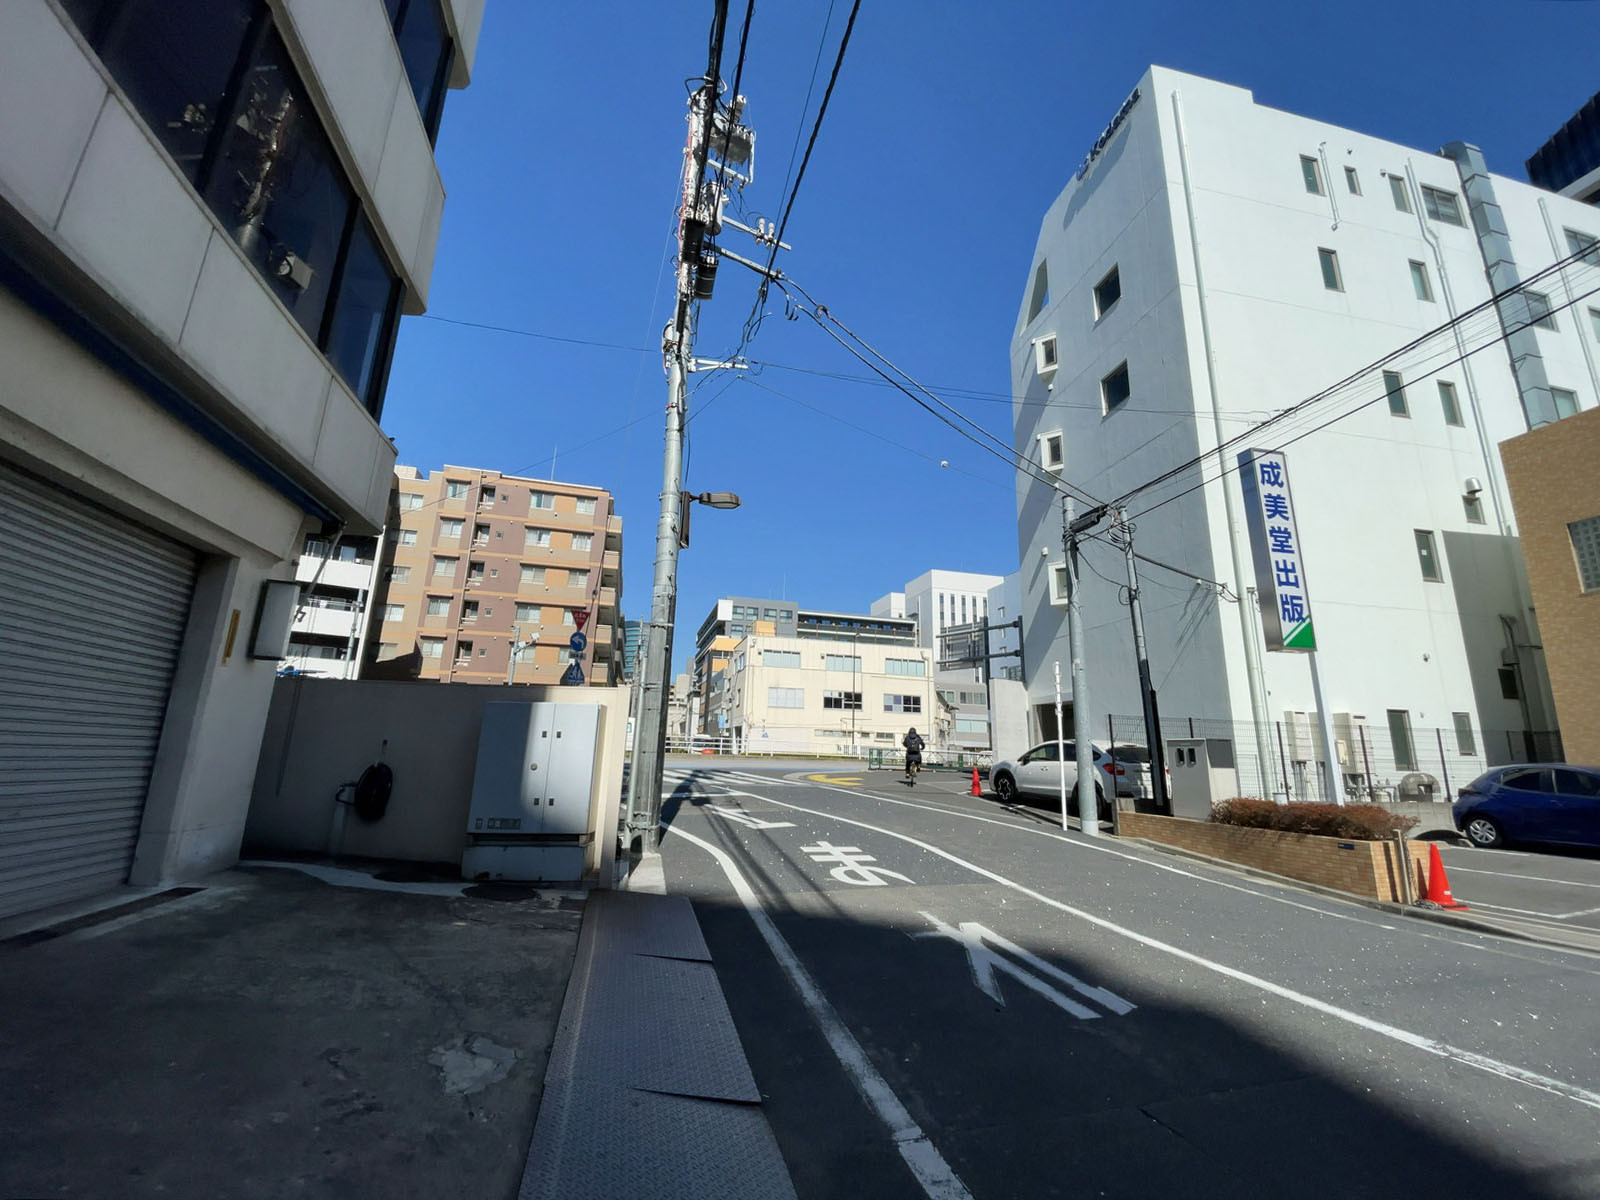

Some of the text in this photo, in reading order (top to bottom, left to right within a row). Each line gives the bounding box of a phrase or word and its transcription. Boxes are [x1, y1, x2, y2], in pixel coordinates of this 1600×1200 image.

[1259, 461, 1306, 624] 成美堂出版
